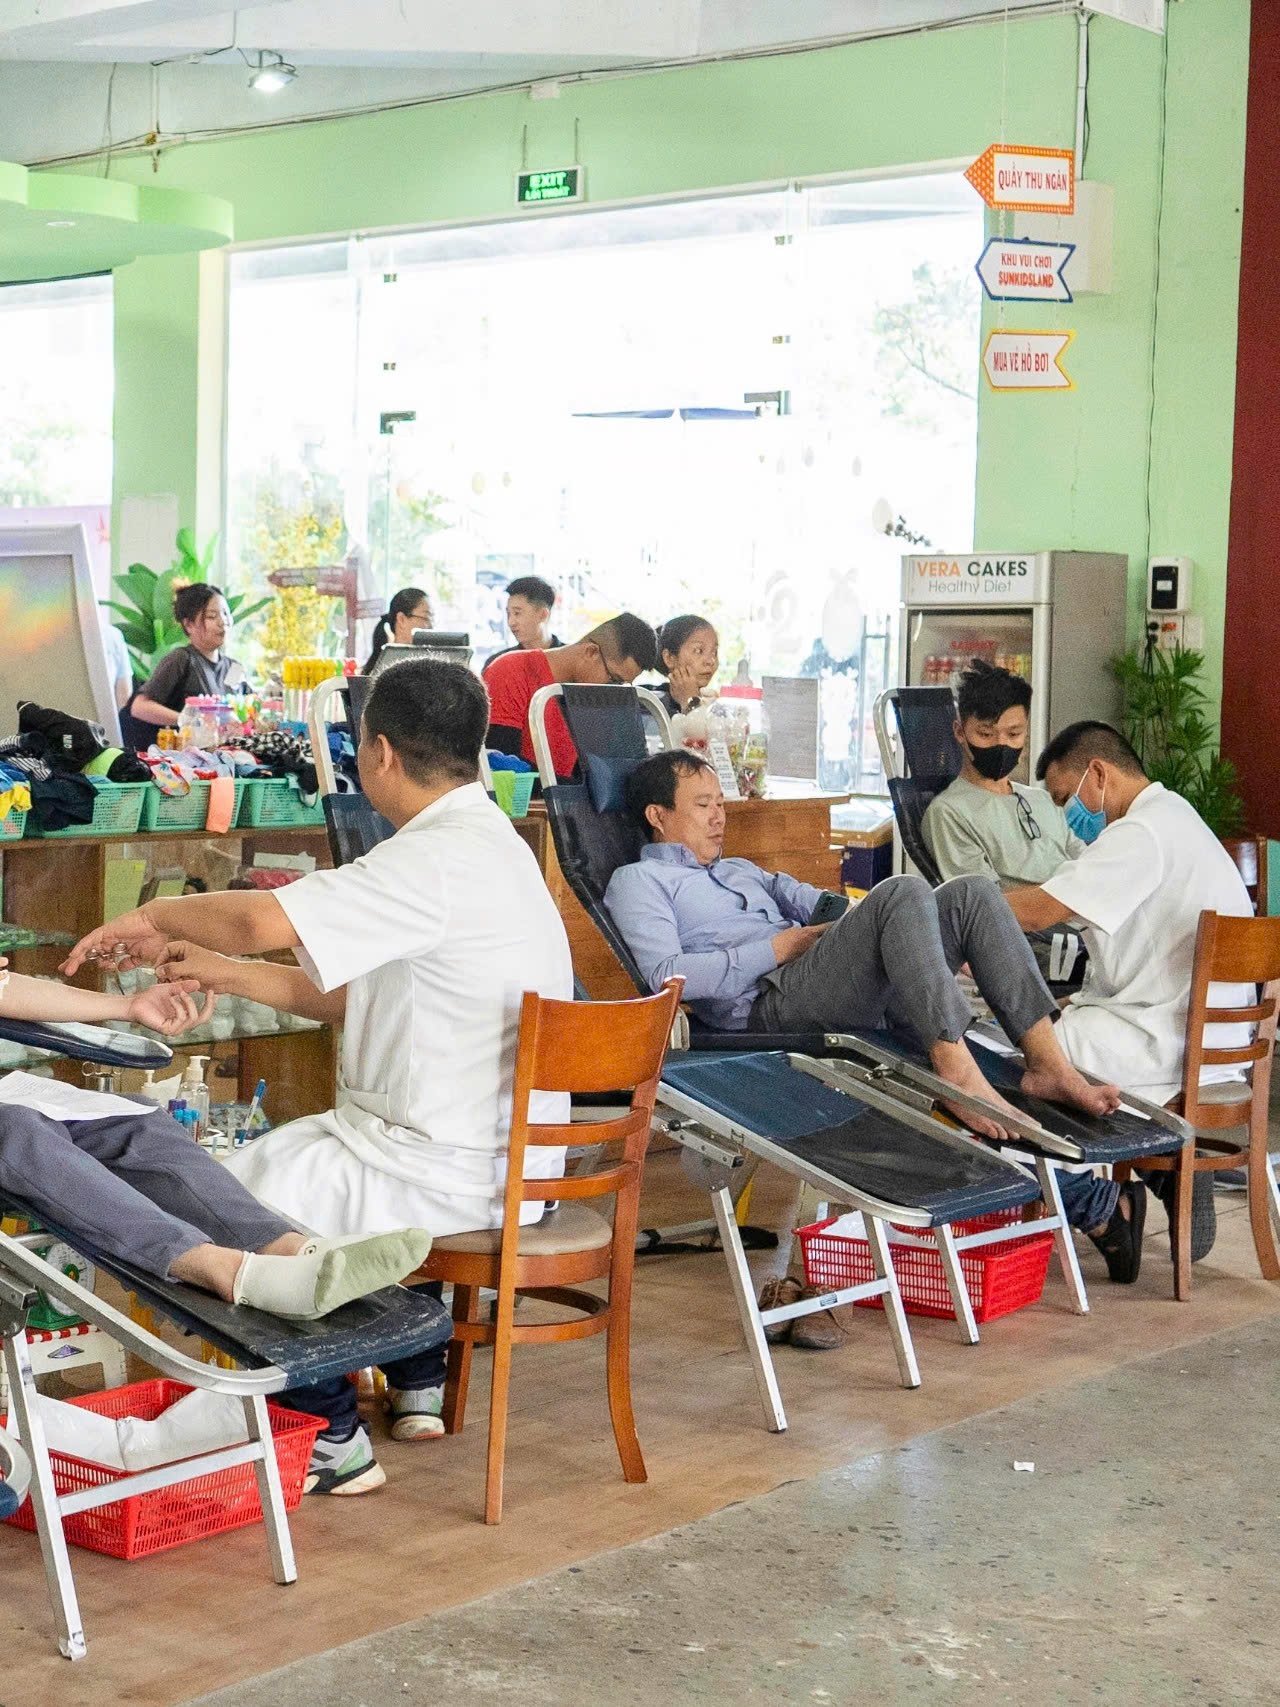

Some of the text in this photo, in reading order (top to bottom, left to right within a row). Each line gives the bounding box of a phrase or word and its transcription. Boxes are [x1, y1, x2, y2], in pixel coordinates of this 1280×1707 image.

[529, 172, 567, 187] EXIT
[1024, 171, 1042, 190] THU
[1045, 169, 1068, 191] NGÂN
[1001, 252, 1018, 266] KHU
[1019, 254, 1032, 267] VUI
[998, 270, 1054, 288] SUNKIDSLAND
[993, 351, 1008, 372] MUA
[917, 561, 1028, 577] VERA CAKES
[928, 579, 1012, 596] Healthy Diet
